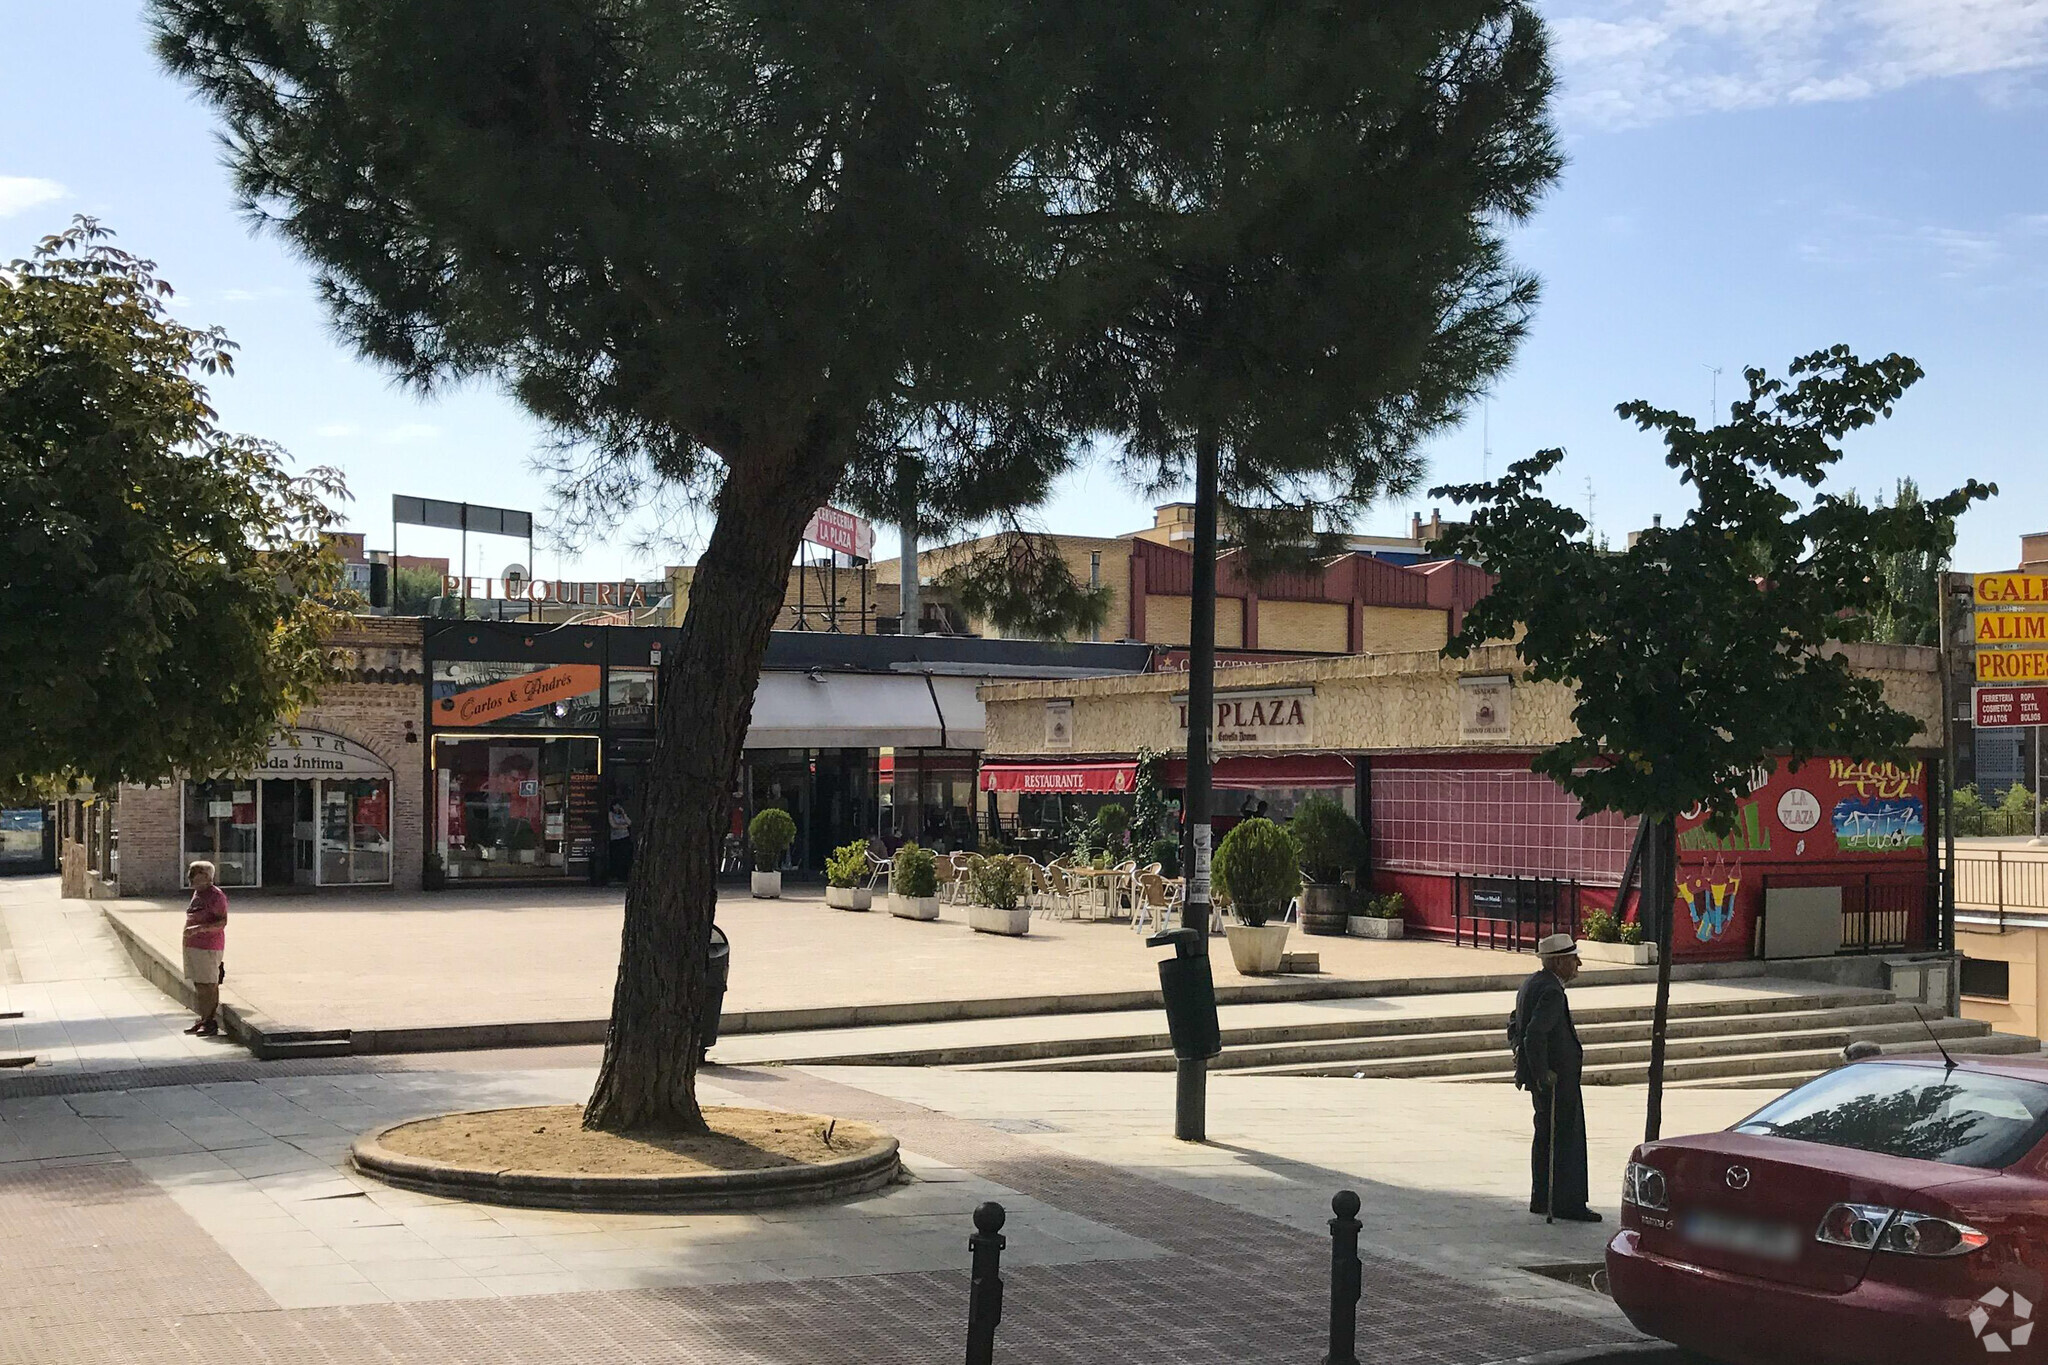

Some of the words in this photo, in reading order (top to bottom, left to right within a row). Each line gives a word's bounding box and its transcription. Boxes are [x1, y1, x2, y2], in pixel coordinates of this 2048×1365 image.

[818, 509, 854, 531] CERVECERIA
[820, 523, 829, 542] LA
[830, 527, 851, 550] PLAZA
[1977, 616, 2046, 639] ALIM
[1979, 653, 2048, 678] PROFE
[460, 697, 502, 720] Carlos
[507, 690, 518, 703] &
[524, 673, 572, 701] Andrés
[2020, 693, 2035, 702] ROPA
[1217, 700, 1304, 728] PLAZA
[1982, 704, 2012, 713] COSMETICO
[2020, 703, 2039, 712] TEXTIL
[1982, 714, 2007, 724] ZAPATOS
[2020, 713, 2041, 722] BOLSOS
[254, 757, 288, 769] oda
[1024, 774, 1084, 788] RESTAURANTE
[1791, 791, 1808, 806] LA
[1782, 810, 1816, 825] PLAZA
